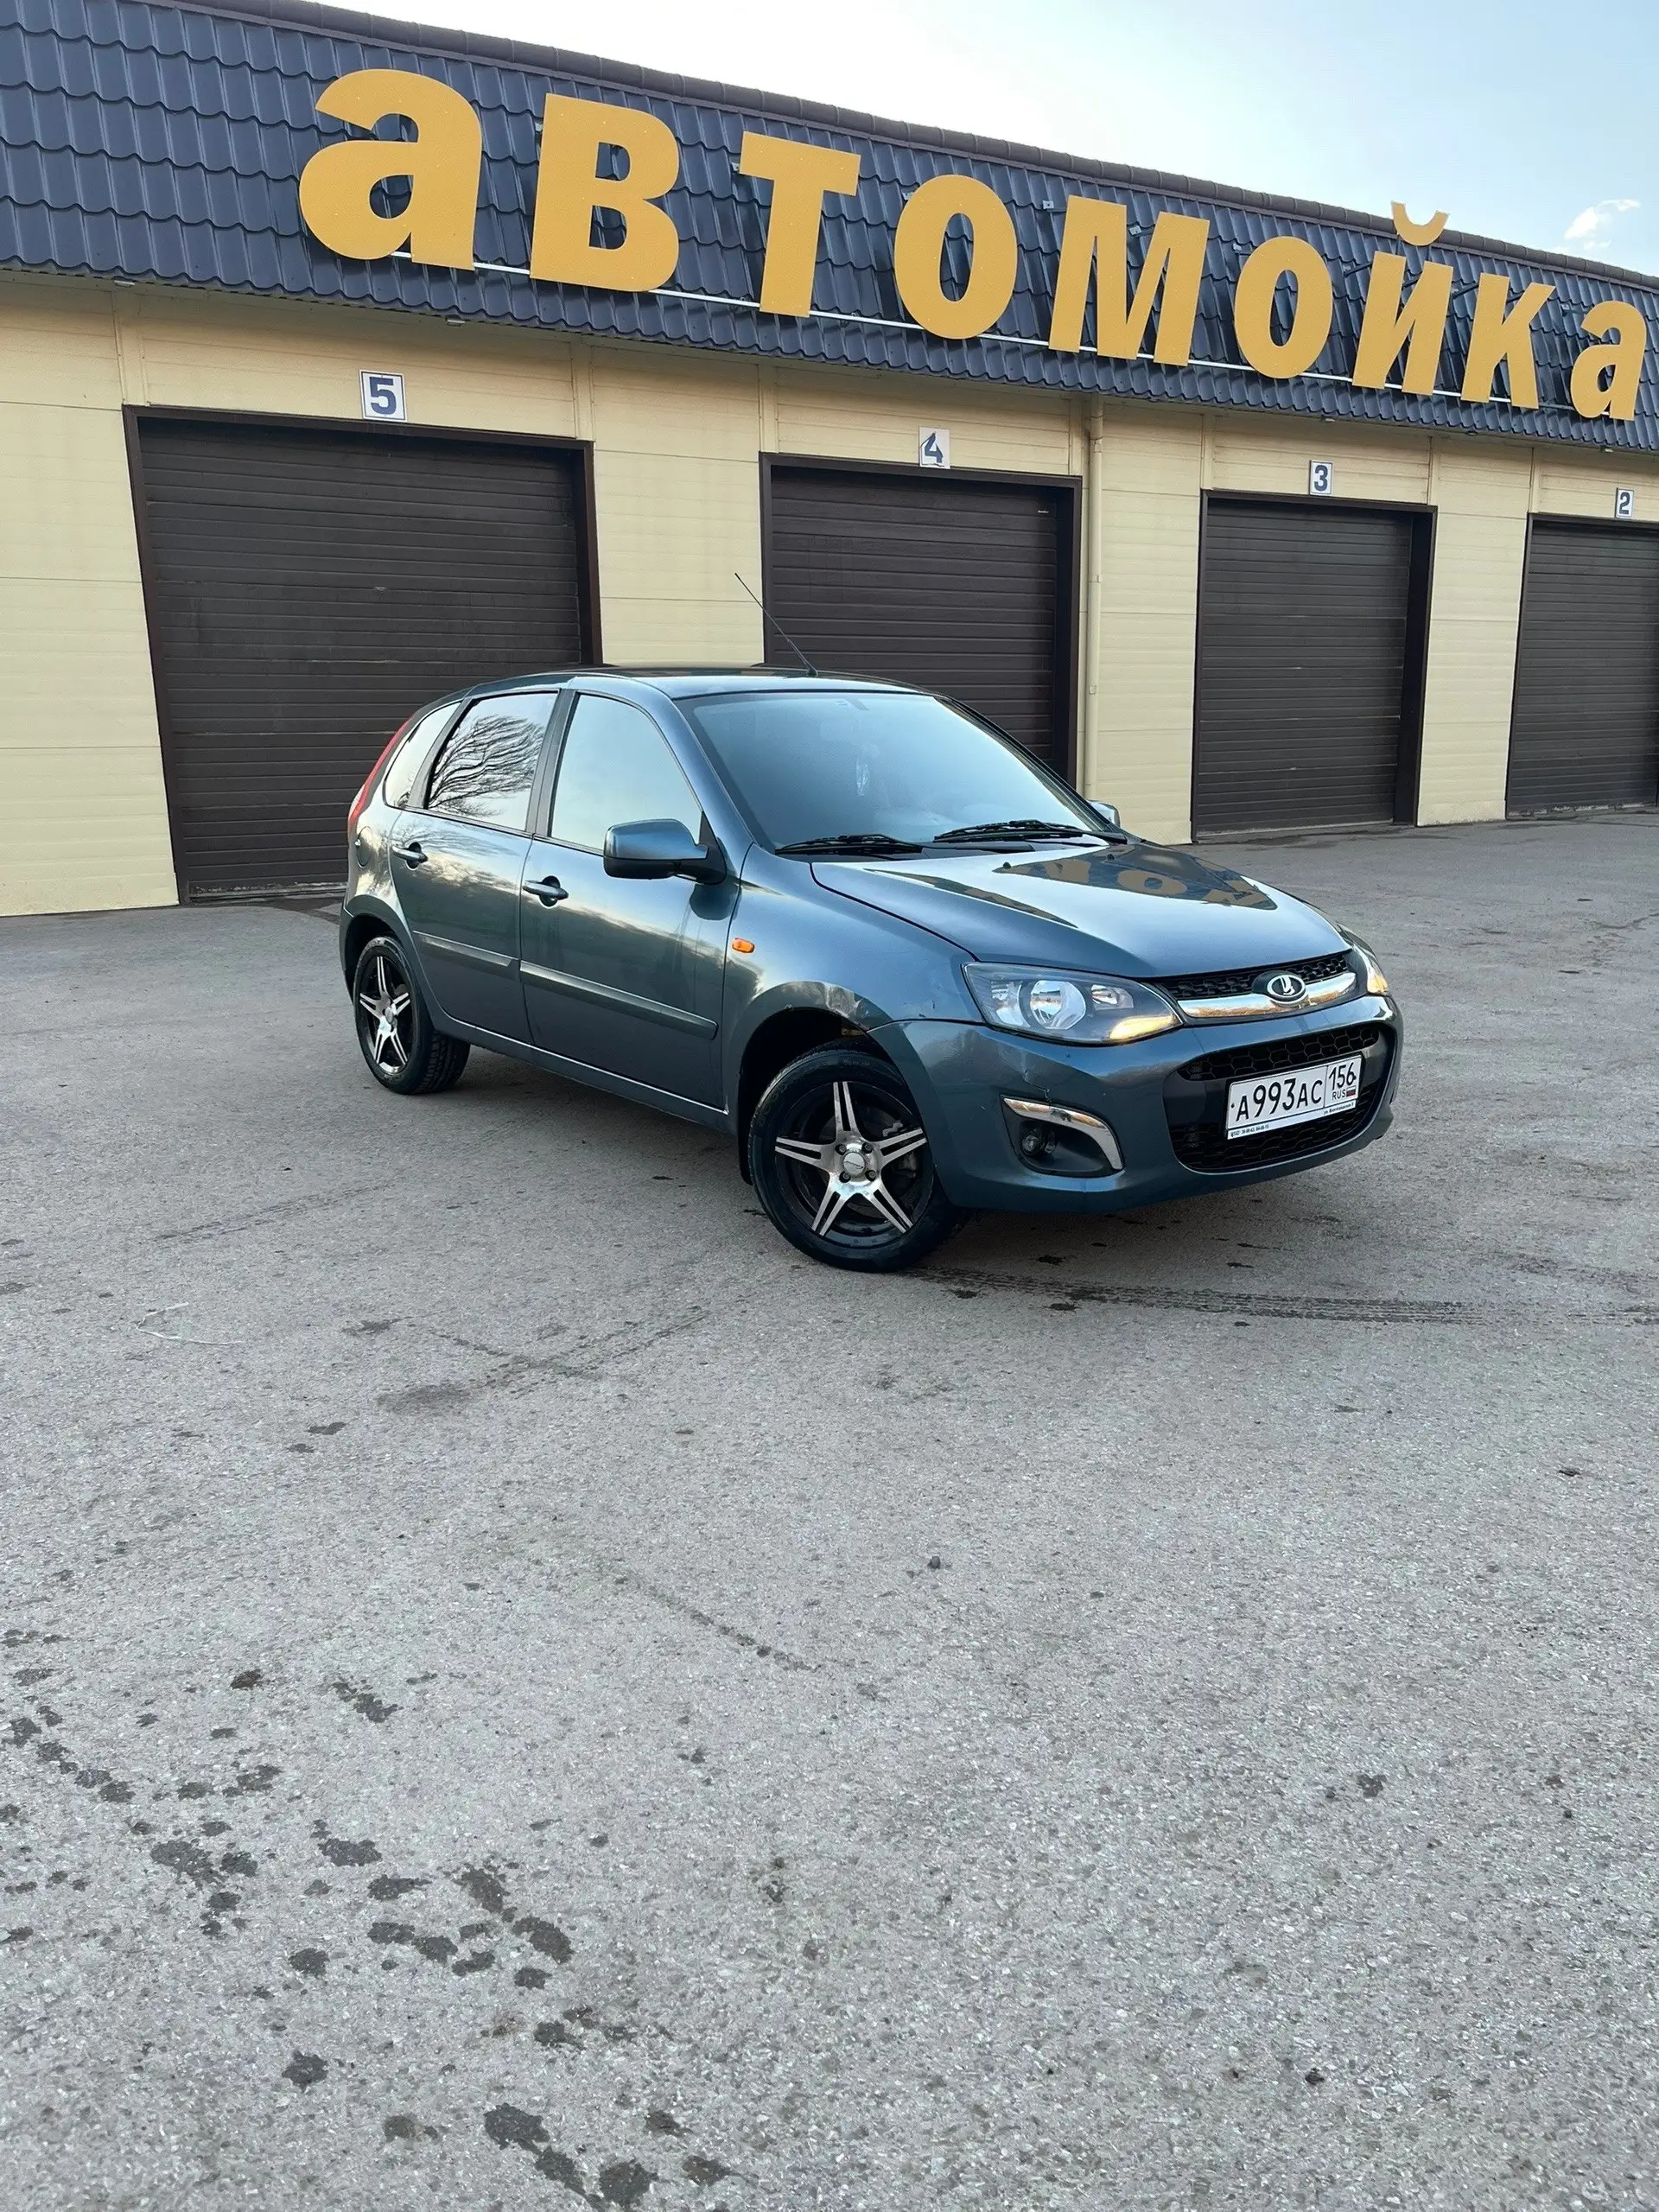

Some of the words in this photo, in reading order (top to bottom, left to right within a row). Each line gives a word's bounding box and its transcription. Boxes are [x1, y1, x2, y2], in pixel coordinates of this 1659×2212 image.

[299, 68, 1647, 421] автомойка
[369, 377, 397, 415] 5
[925, 433, 944, 463] 4
[1314, 465, 1328, 492] 3
[1619, 492, 1630, 515] 2
[1329, 1062, 1354, 1090] 156
[1332, 1089, 1346, 1100] RUS
